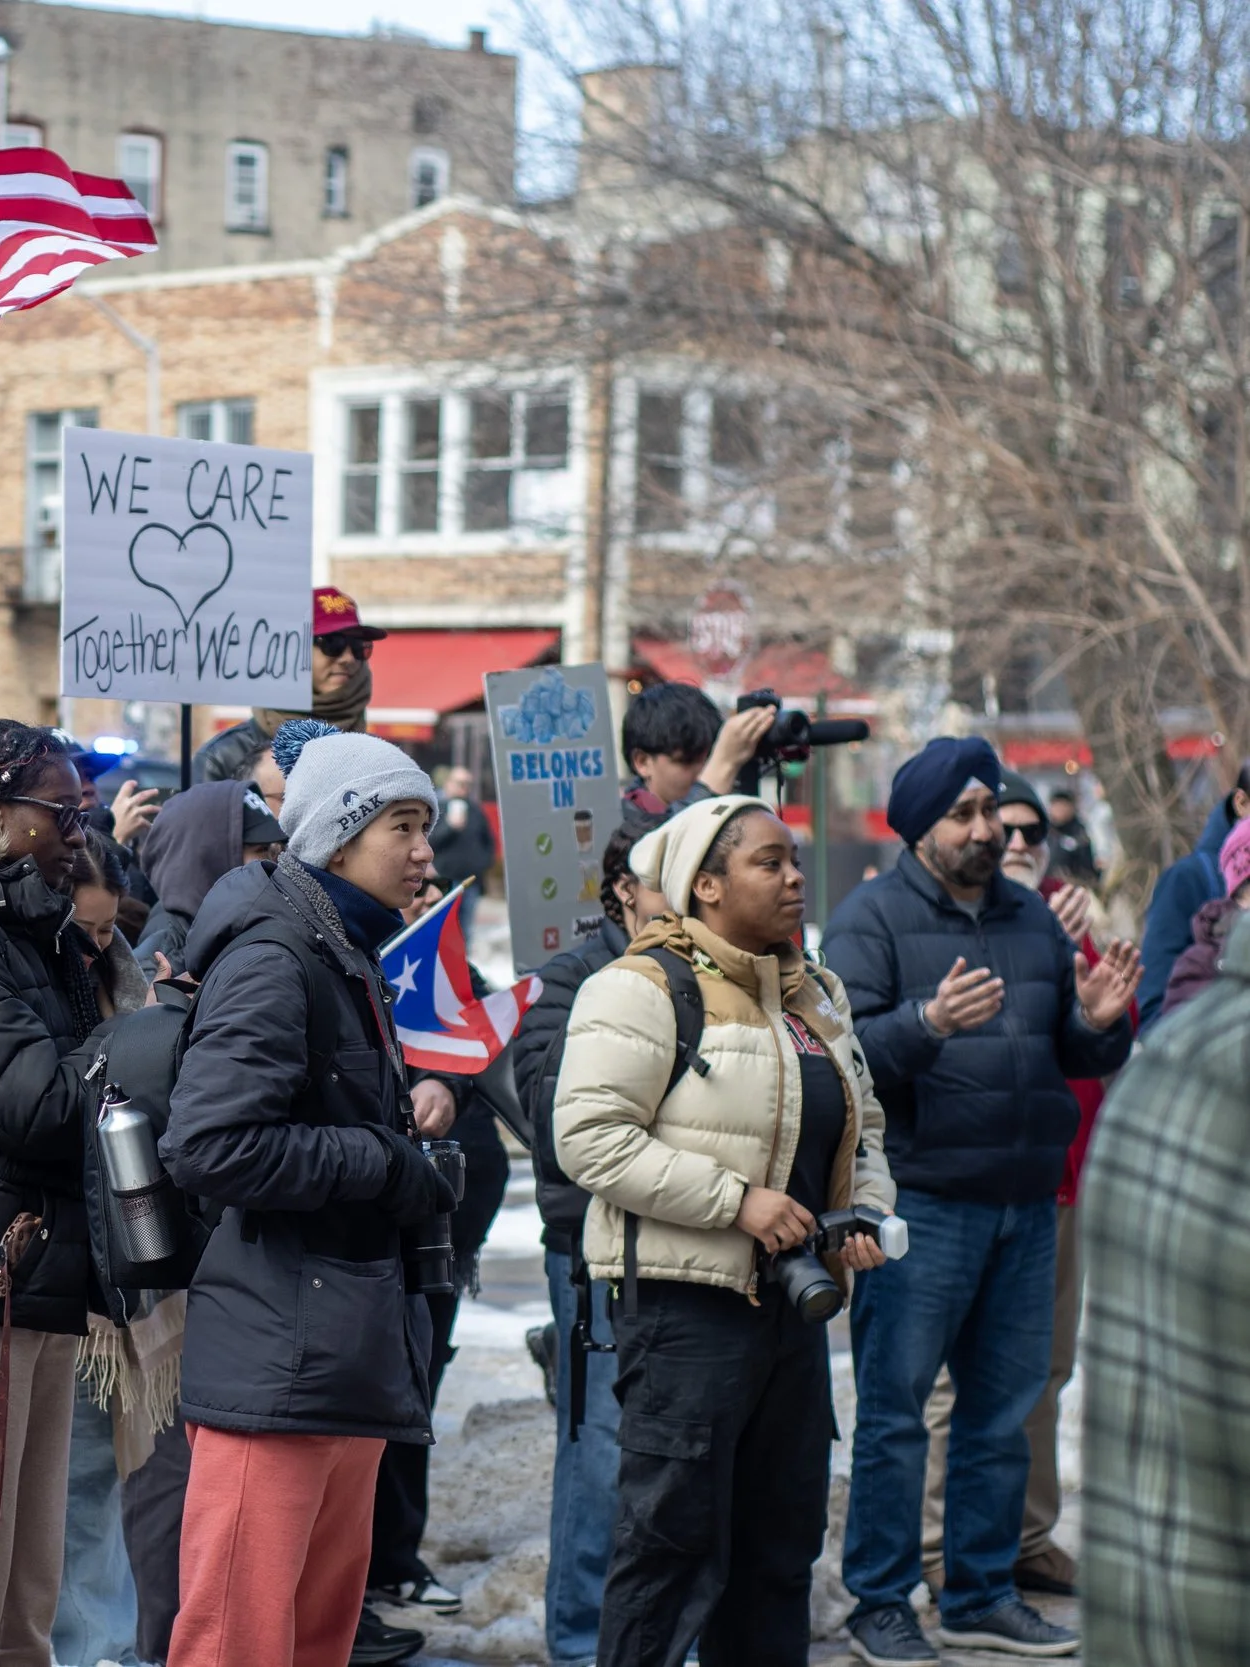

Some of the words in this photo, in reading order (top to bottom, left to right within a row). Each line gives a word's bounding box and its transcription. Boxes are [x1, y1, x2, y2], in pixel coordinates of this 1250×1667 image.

[81, 452, 151, 515] WE
[186, 459, 293, 530] CARE
[195, 611, 240, 682] We
[510, 748, 603, 782] BELONGS
[553, 779, 575, 808] IN
[338, 794, 385, 831] PEAK
